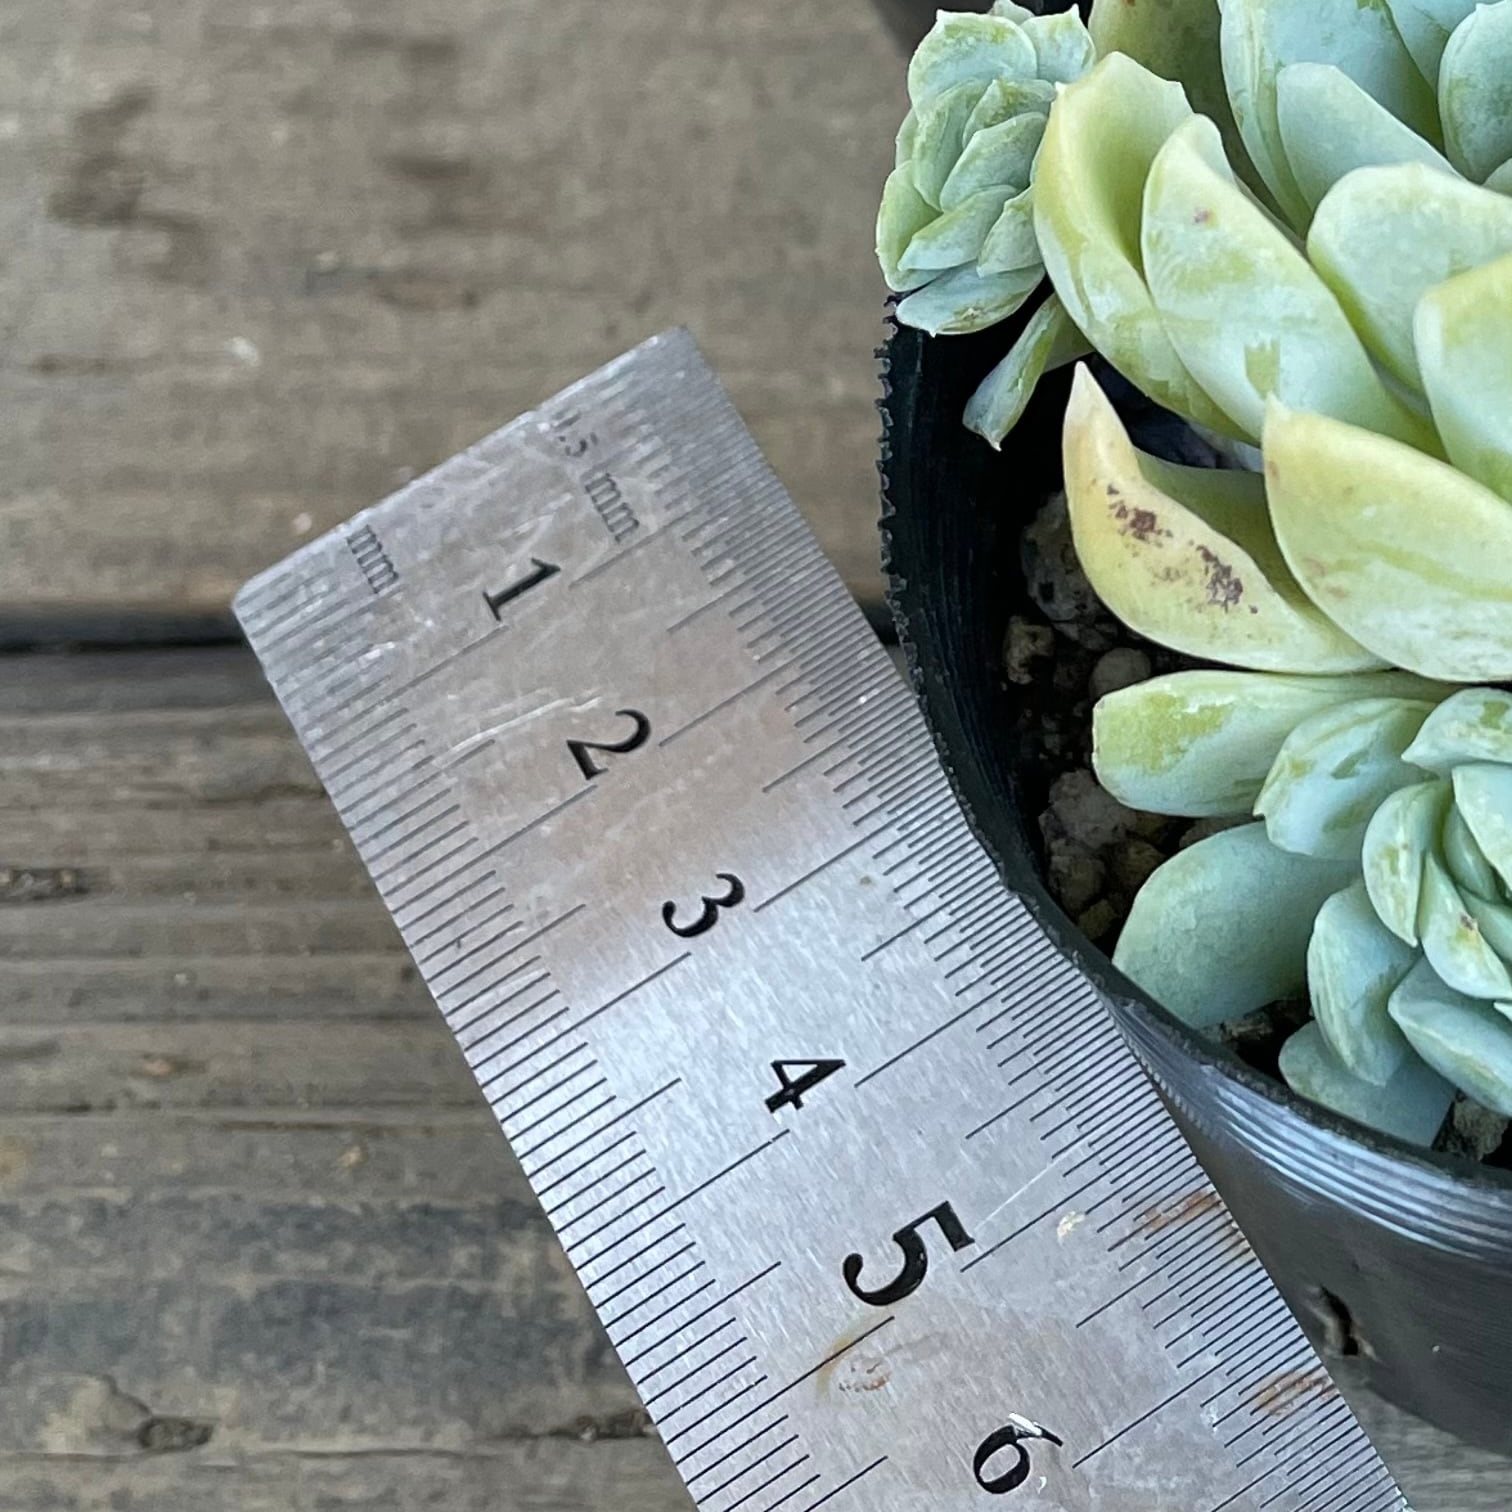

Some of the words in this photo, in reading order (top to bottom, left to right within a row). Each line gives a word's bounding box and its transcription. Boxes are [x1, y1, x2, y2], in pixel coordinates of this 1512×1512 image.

[345, 524, 400, 594] mm
[482, 557, 562, 621] 1
[566, 709, 651, 780] 2
[661, 873, 746, 938] 3
[765, 1058, 847, 1115] 4
[842, 1200, 976, 1306] 5
[972, 1414, 1064, 1494] 6
